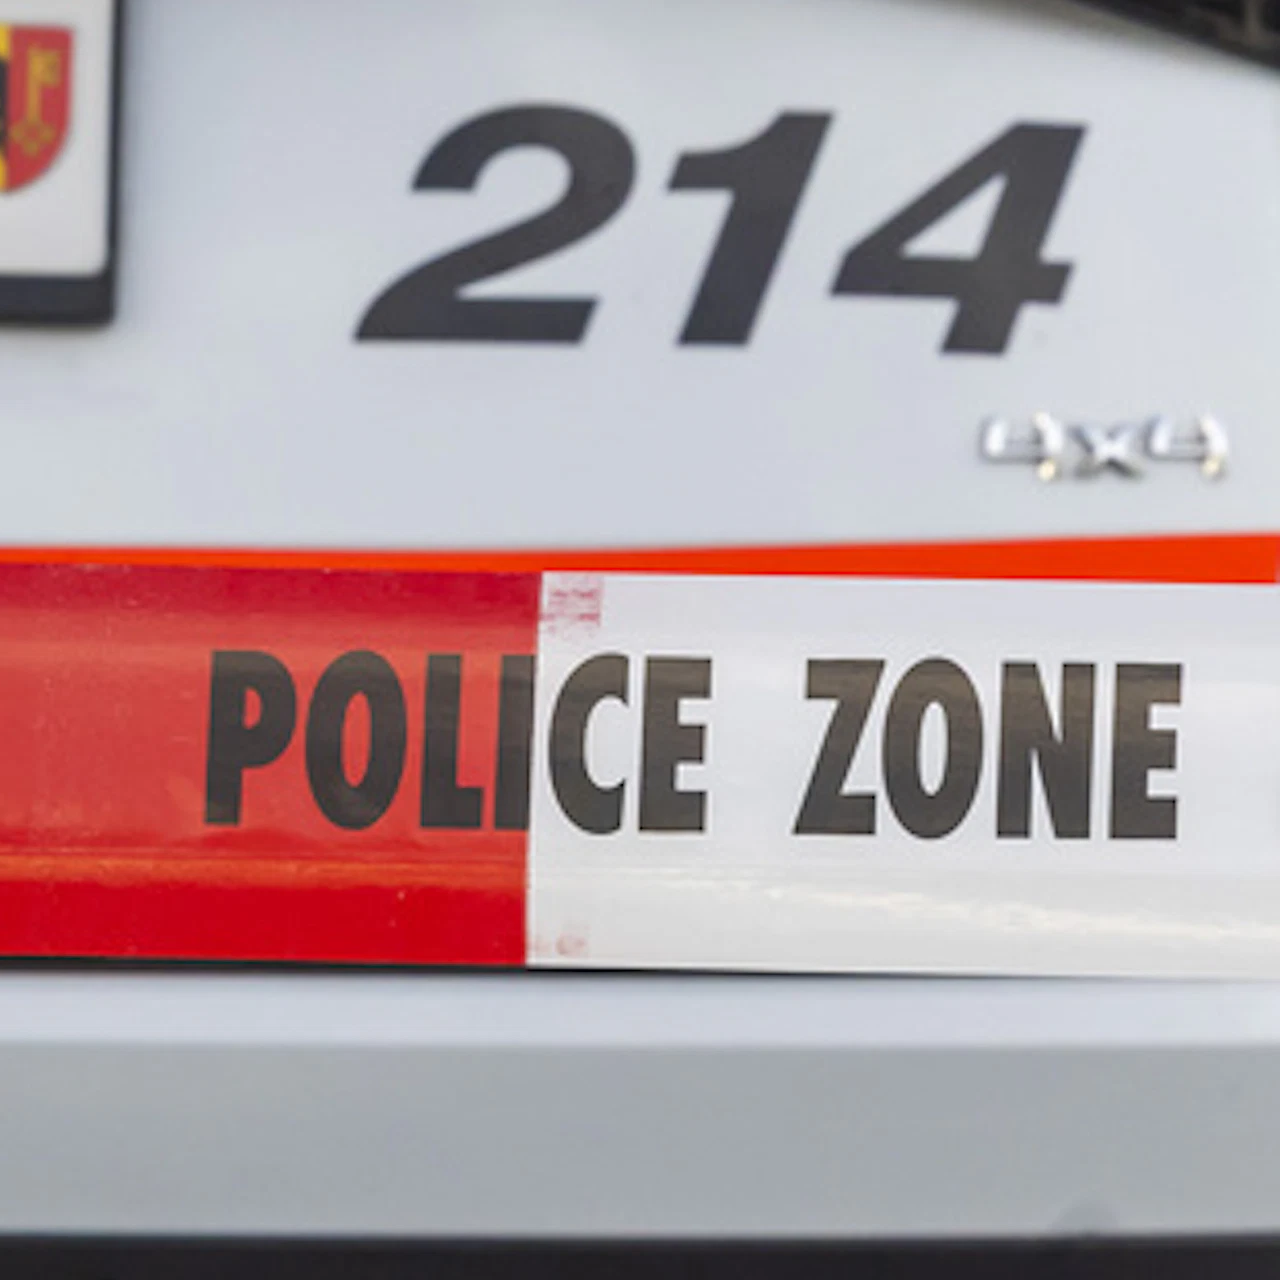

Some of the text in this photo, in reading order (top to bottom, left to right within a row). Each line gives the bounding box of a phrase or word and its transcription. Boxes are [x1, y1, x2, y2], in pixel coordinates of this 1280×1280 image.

[352, 101, 1090, 358] 214
[980, 410, 1232, 484] 4x4
[203, 648, 713, 835] POLICE
[792, 656, 1185, 842] ZONE
